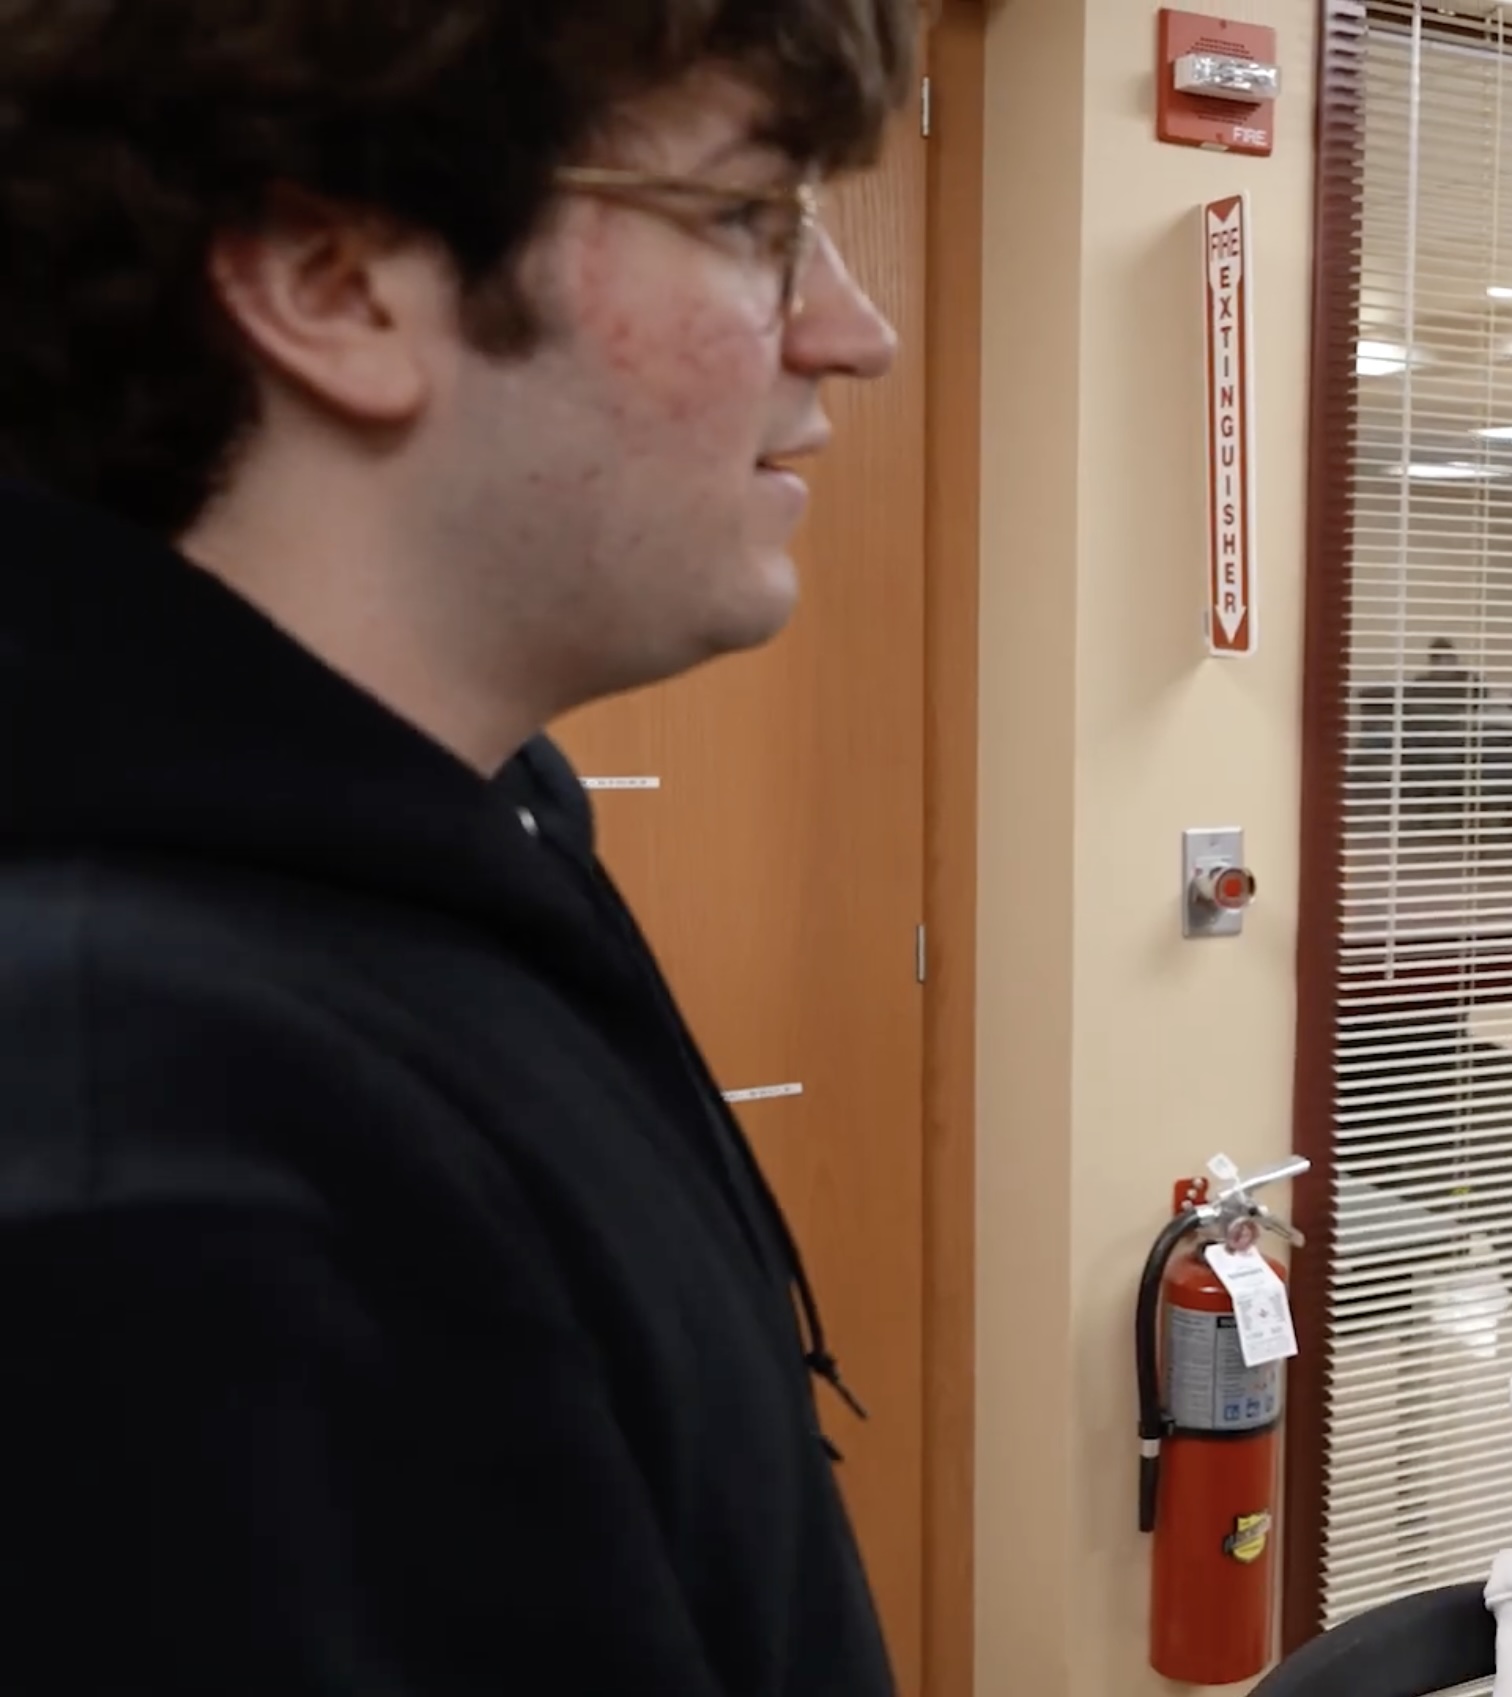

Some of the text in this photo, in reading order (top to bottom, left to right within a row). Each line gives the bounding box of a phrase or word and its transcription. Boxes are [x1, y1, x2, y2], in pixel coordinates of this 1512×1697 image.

[1232, 127, 1268, 146] FIRE
[1210, 227, 1239, 261] FIRE
[1219, 266, 1236, 613] EXTINGUISHER
